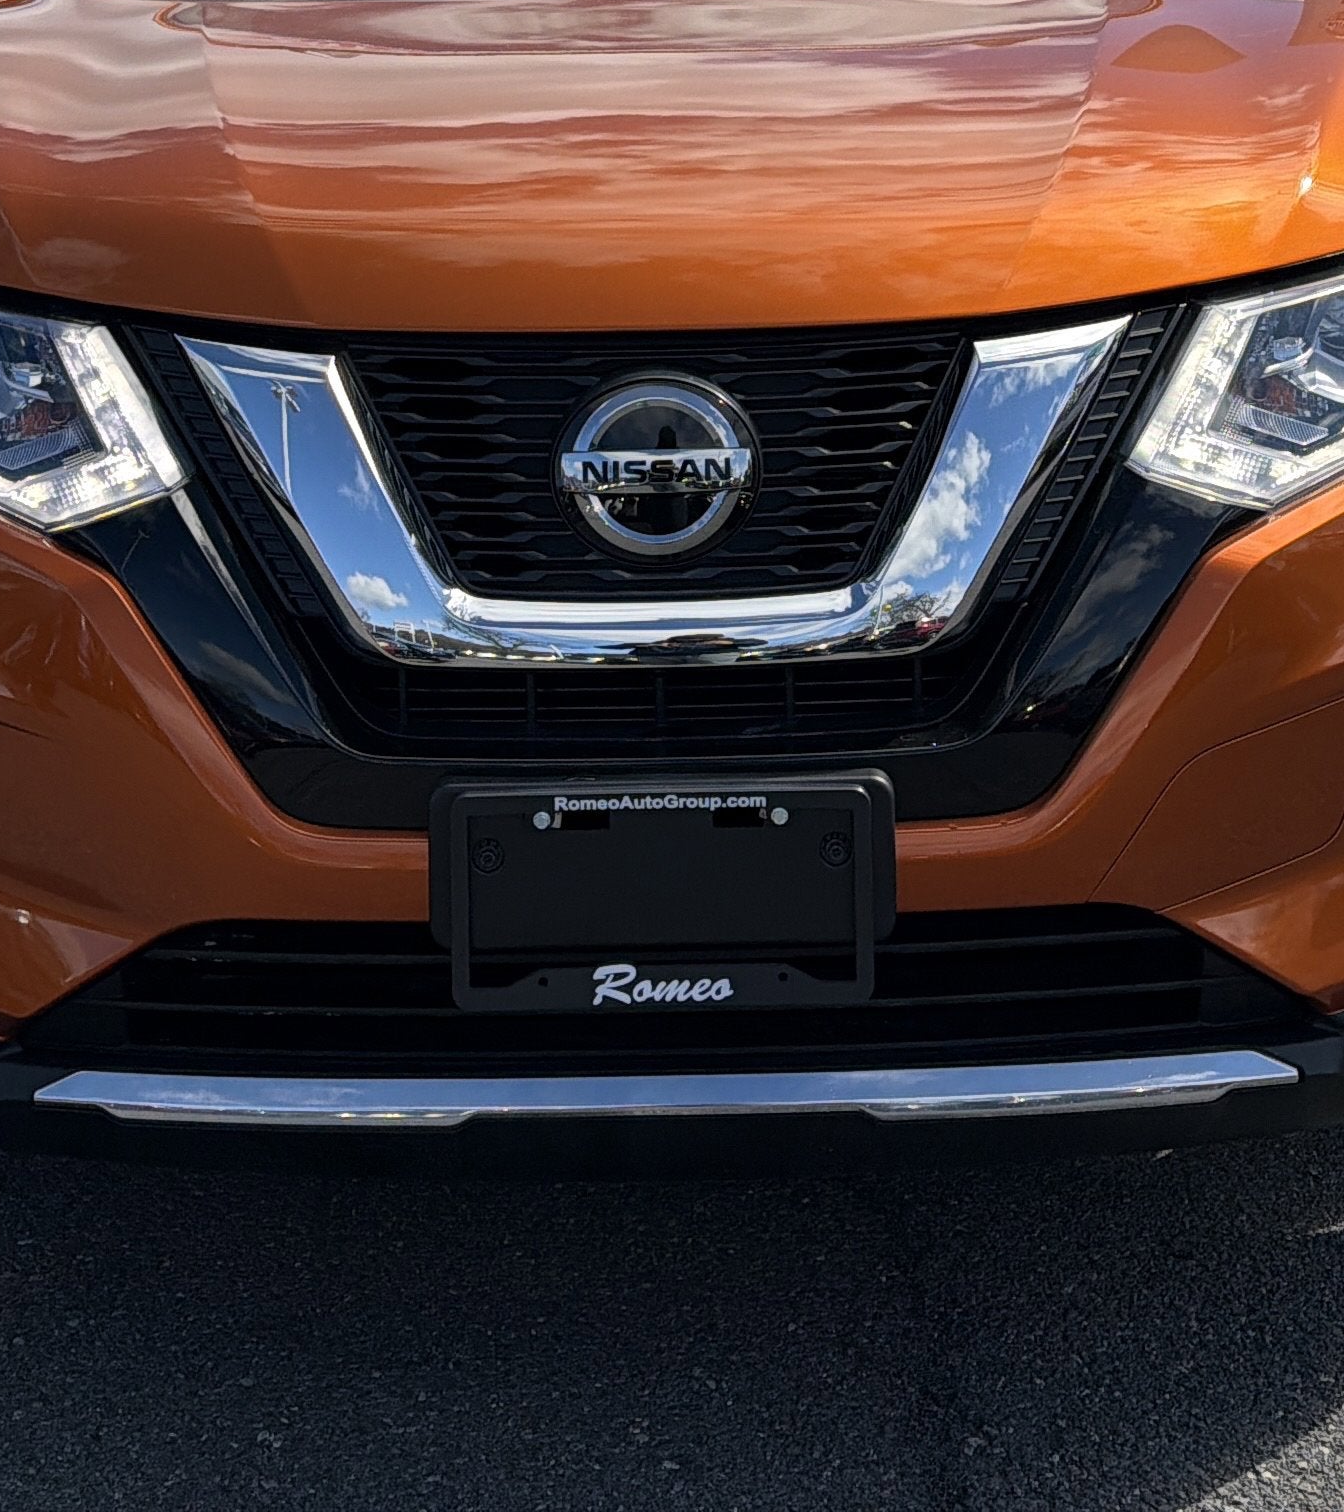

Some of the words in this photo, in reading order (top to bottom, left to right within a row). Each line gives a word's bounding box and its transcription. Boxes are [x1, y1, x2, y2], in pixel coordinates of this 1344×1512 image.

[581, 456, 732, 485] NISSAN
[554, 794, 768, 812] RomeoAutoGroup.com
[592, 963, 735, 1006] Romeo
